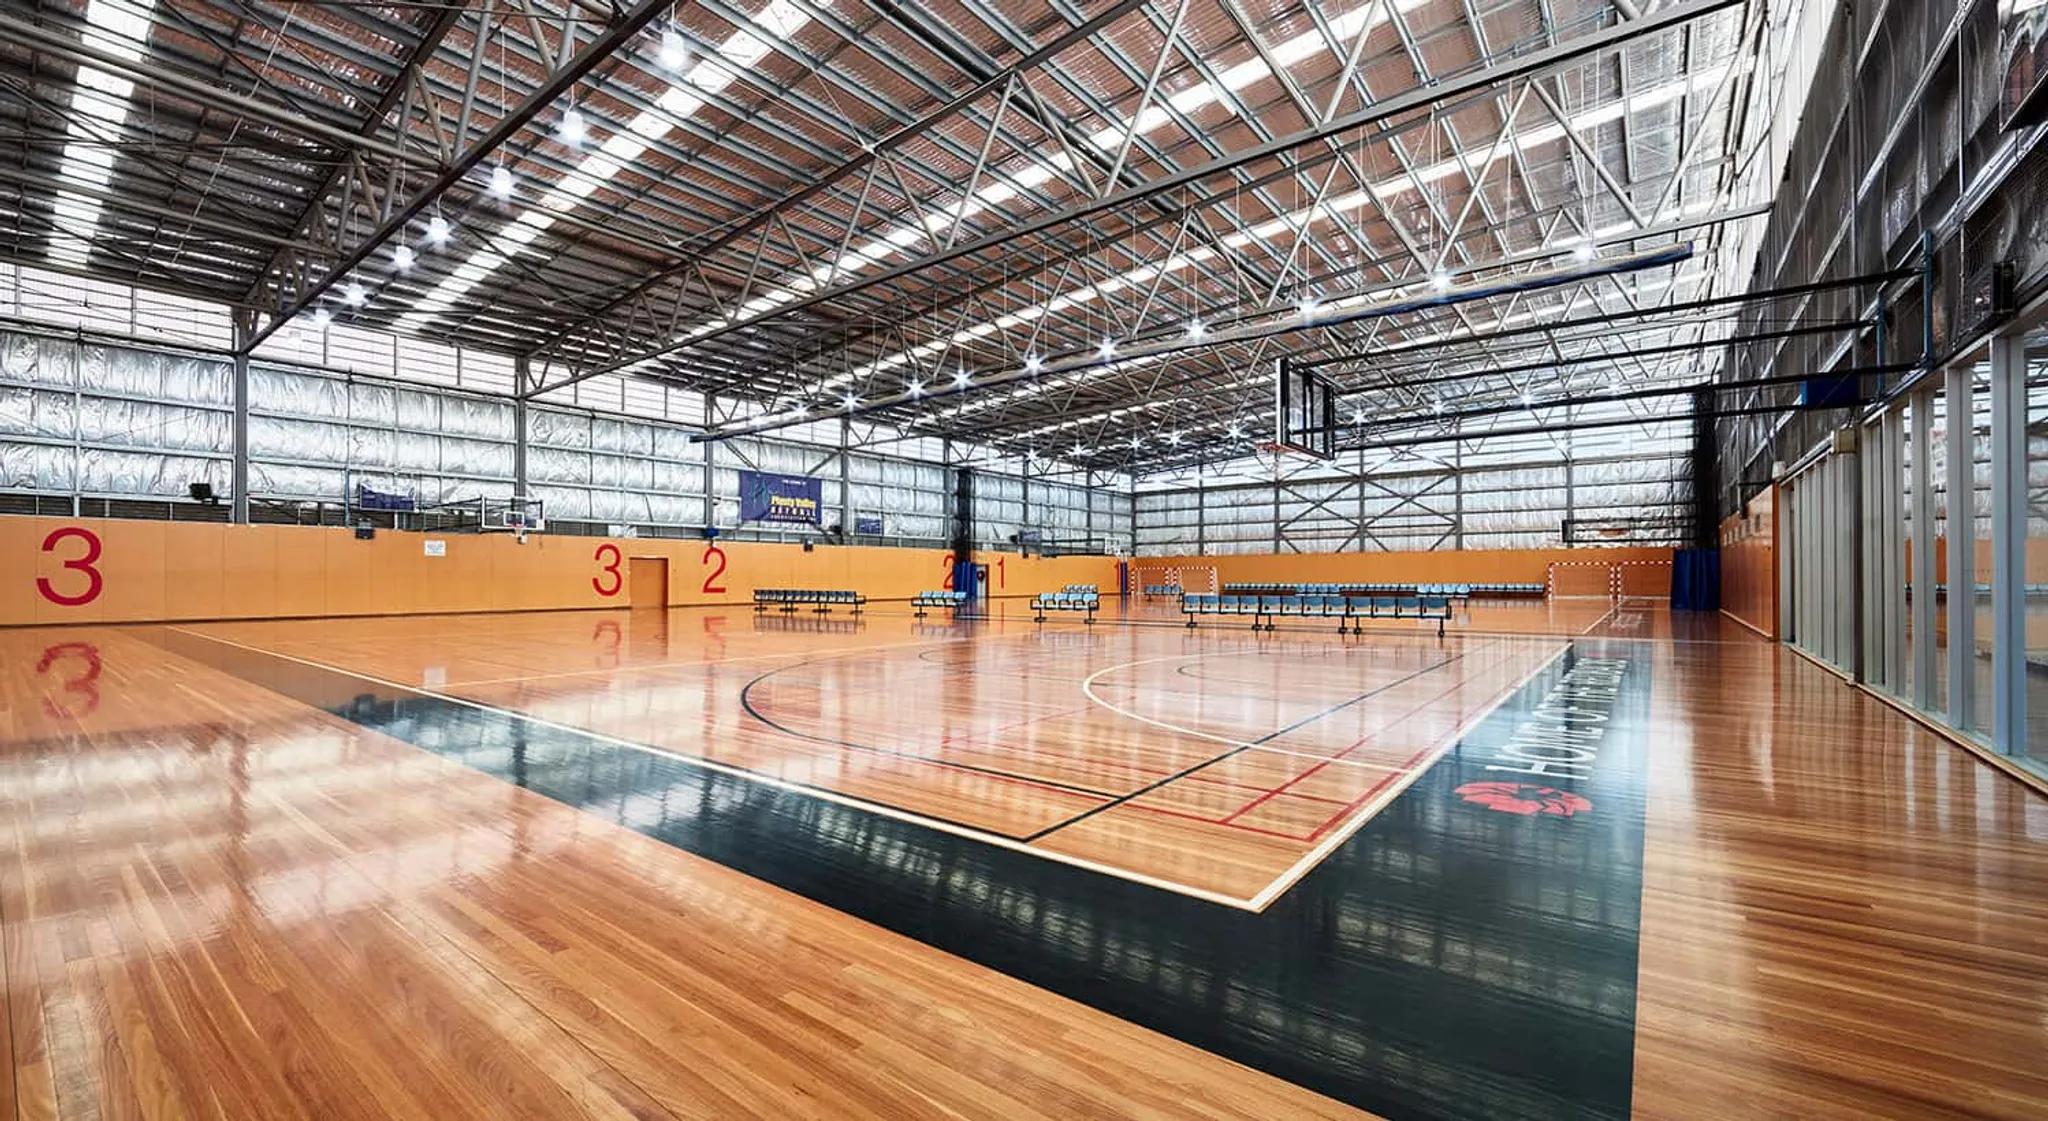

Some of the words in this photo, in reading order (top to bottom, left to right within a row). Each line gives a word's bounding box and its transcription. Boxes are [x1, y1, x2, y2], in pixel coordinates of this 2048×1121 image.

[36, 527, 102, 606] 3
[592, 543, 622, 596] 3
[702, 546, 727, 593] 2
[943, 554, 956, 589] 2
[997, 556, 1005, 589] 1
[1485, 721, 1605, 780] HOME
